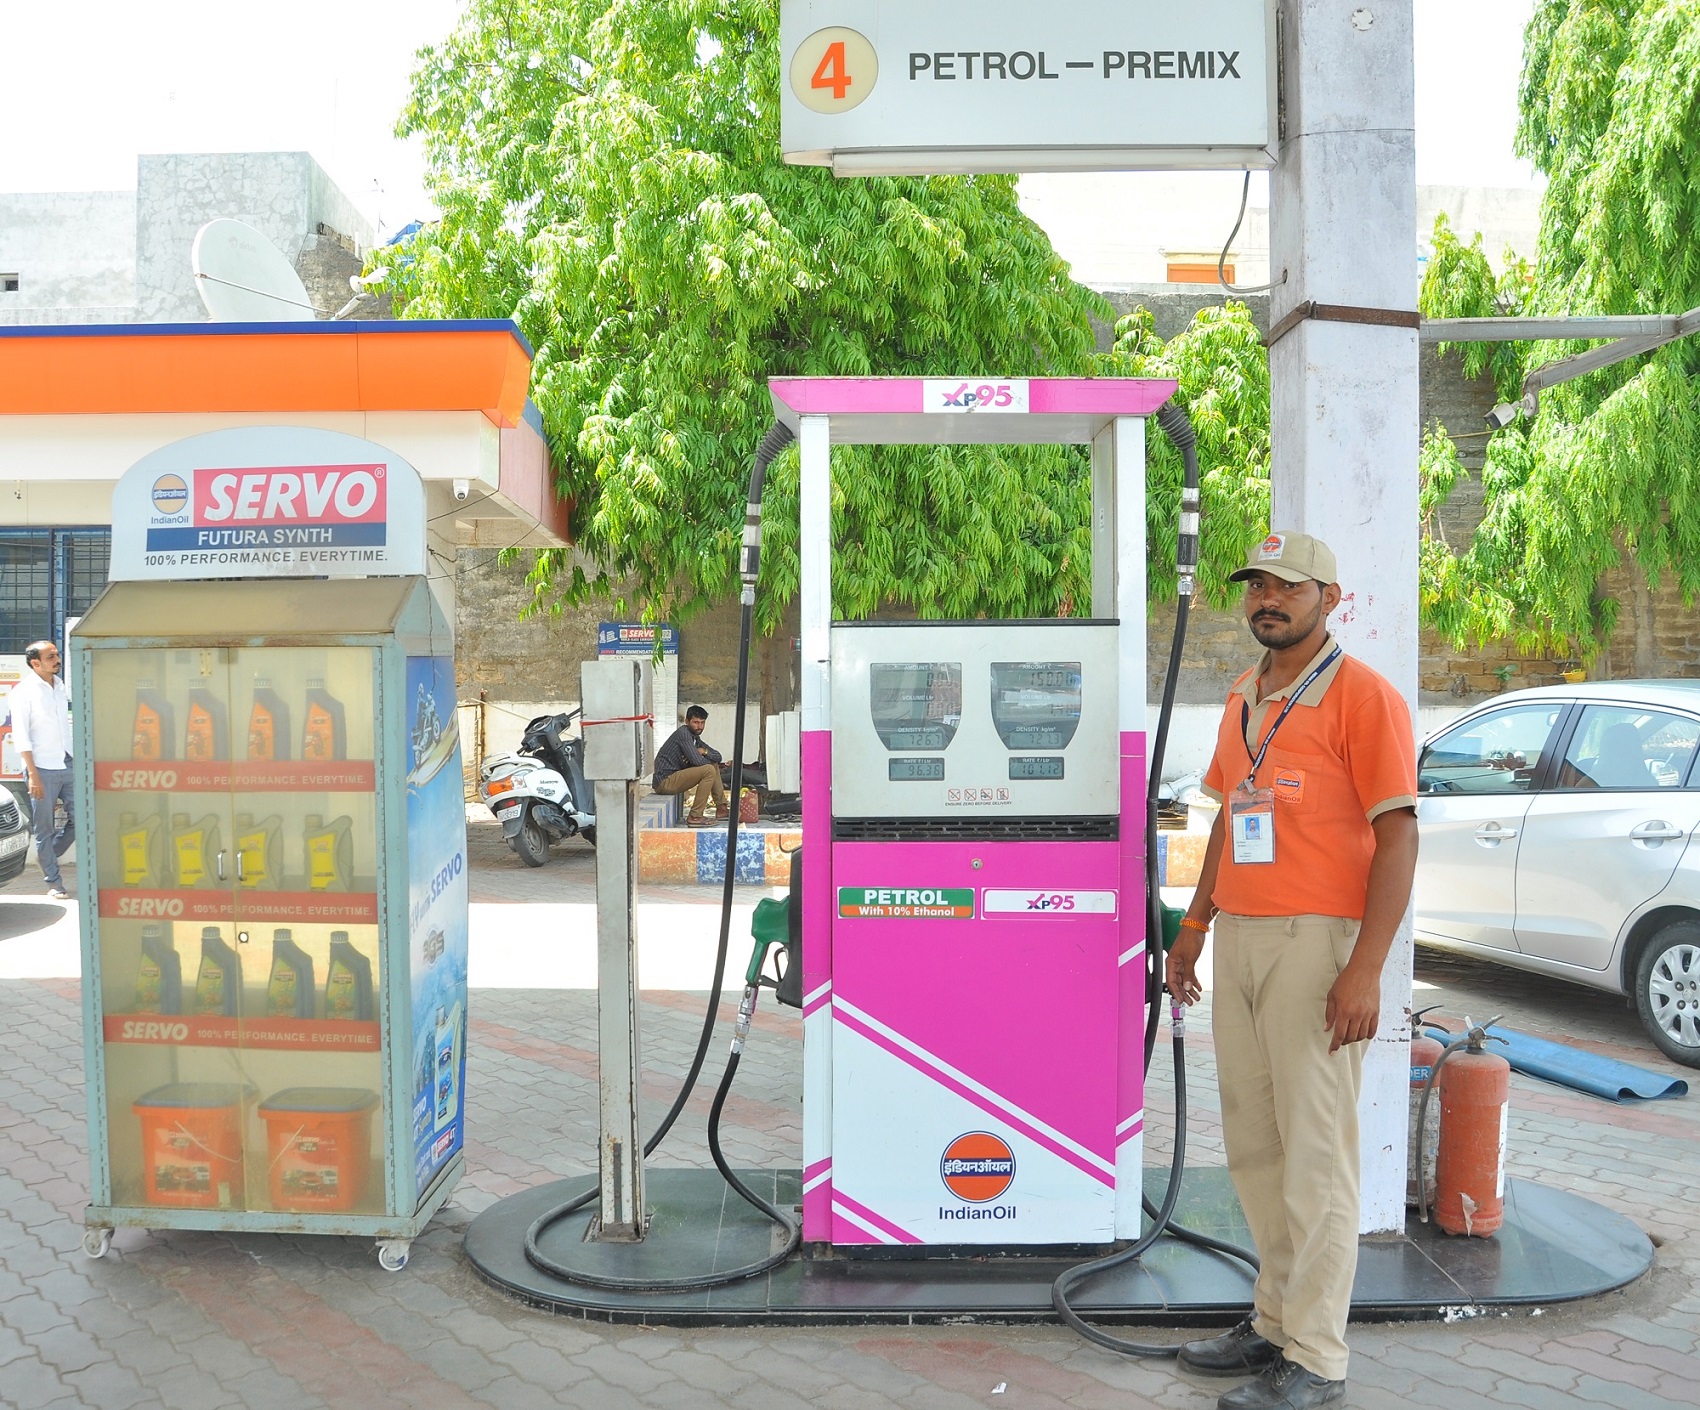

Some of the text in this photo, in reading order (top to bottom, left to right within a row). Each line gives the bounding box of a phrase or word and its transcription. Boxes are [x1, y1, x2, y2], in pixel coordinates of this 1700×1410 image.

[810, 41, 852, 98] 4
[909, 51, 1059, 80] PETROL
[1104, 51, 1240, 79] PREMIX
[941, 383, 1012, 406] XP95
[151, 515, 189, 525] IndianOil
[198, 528, 333, 546] FUTURA SYNTH
[144, 550, 388, 566] 100% PERFORMANCE. EVERYTIME.
[908, 764, 940, 776] 96.36
[110, 770, 367, 788] SERVO 100% PERFORMANCE. EVERYTIME.
[431, 852, 462, 903] SERVO
[864, 889, 949, 905] PETROL
[1026, 893, 1075, 910] XP95
[117, 897, 373, 916] SERVO 100% PERFORMANCE. EVERYTIME.
[859, 906, 955, 917] With 10% Ethanol
[122, 1021, 376, 1044] SERVO 100% PERFORMANCE. EVERYTIME.
[944, 1159, 1012, 1175] इंडियनऑयल
[939, 1206, 1016, 1220] IndianOil
